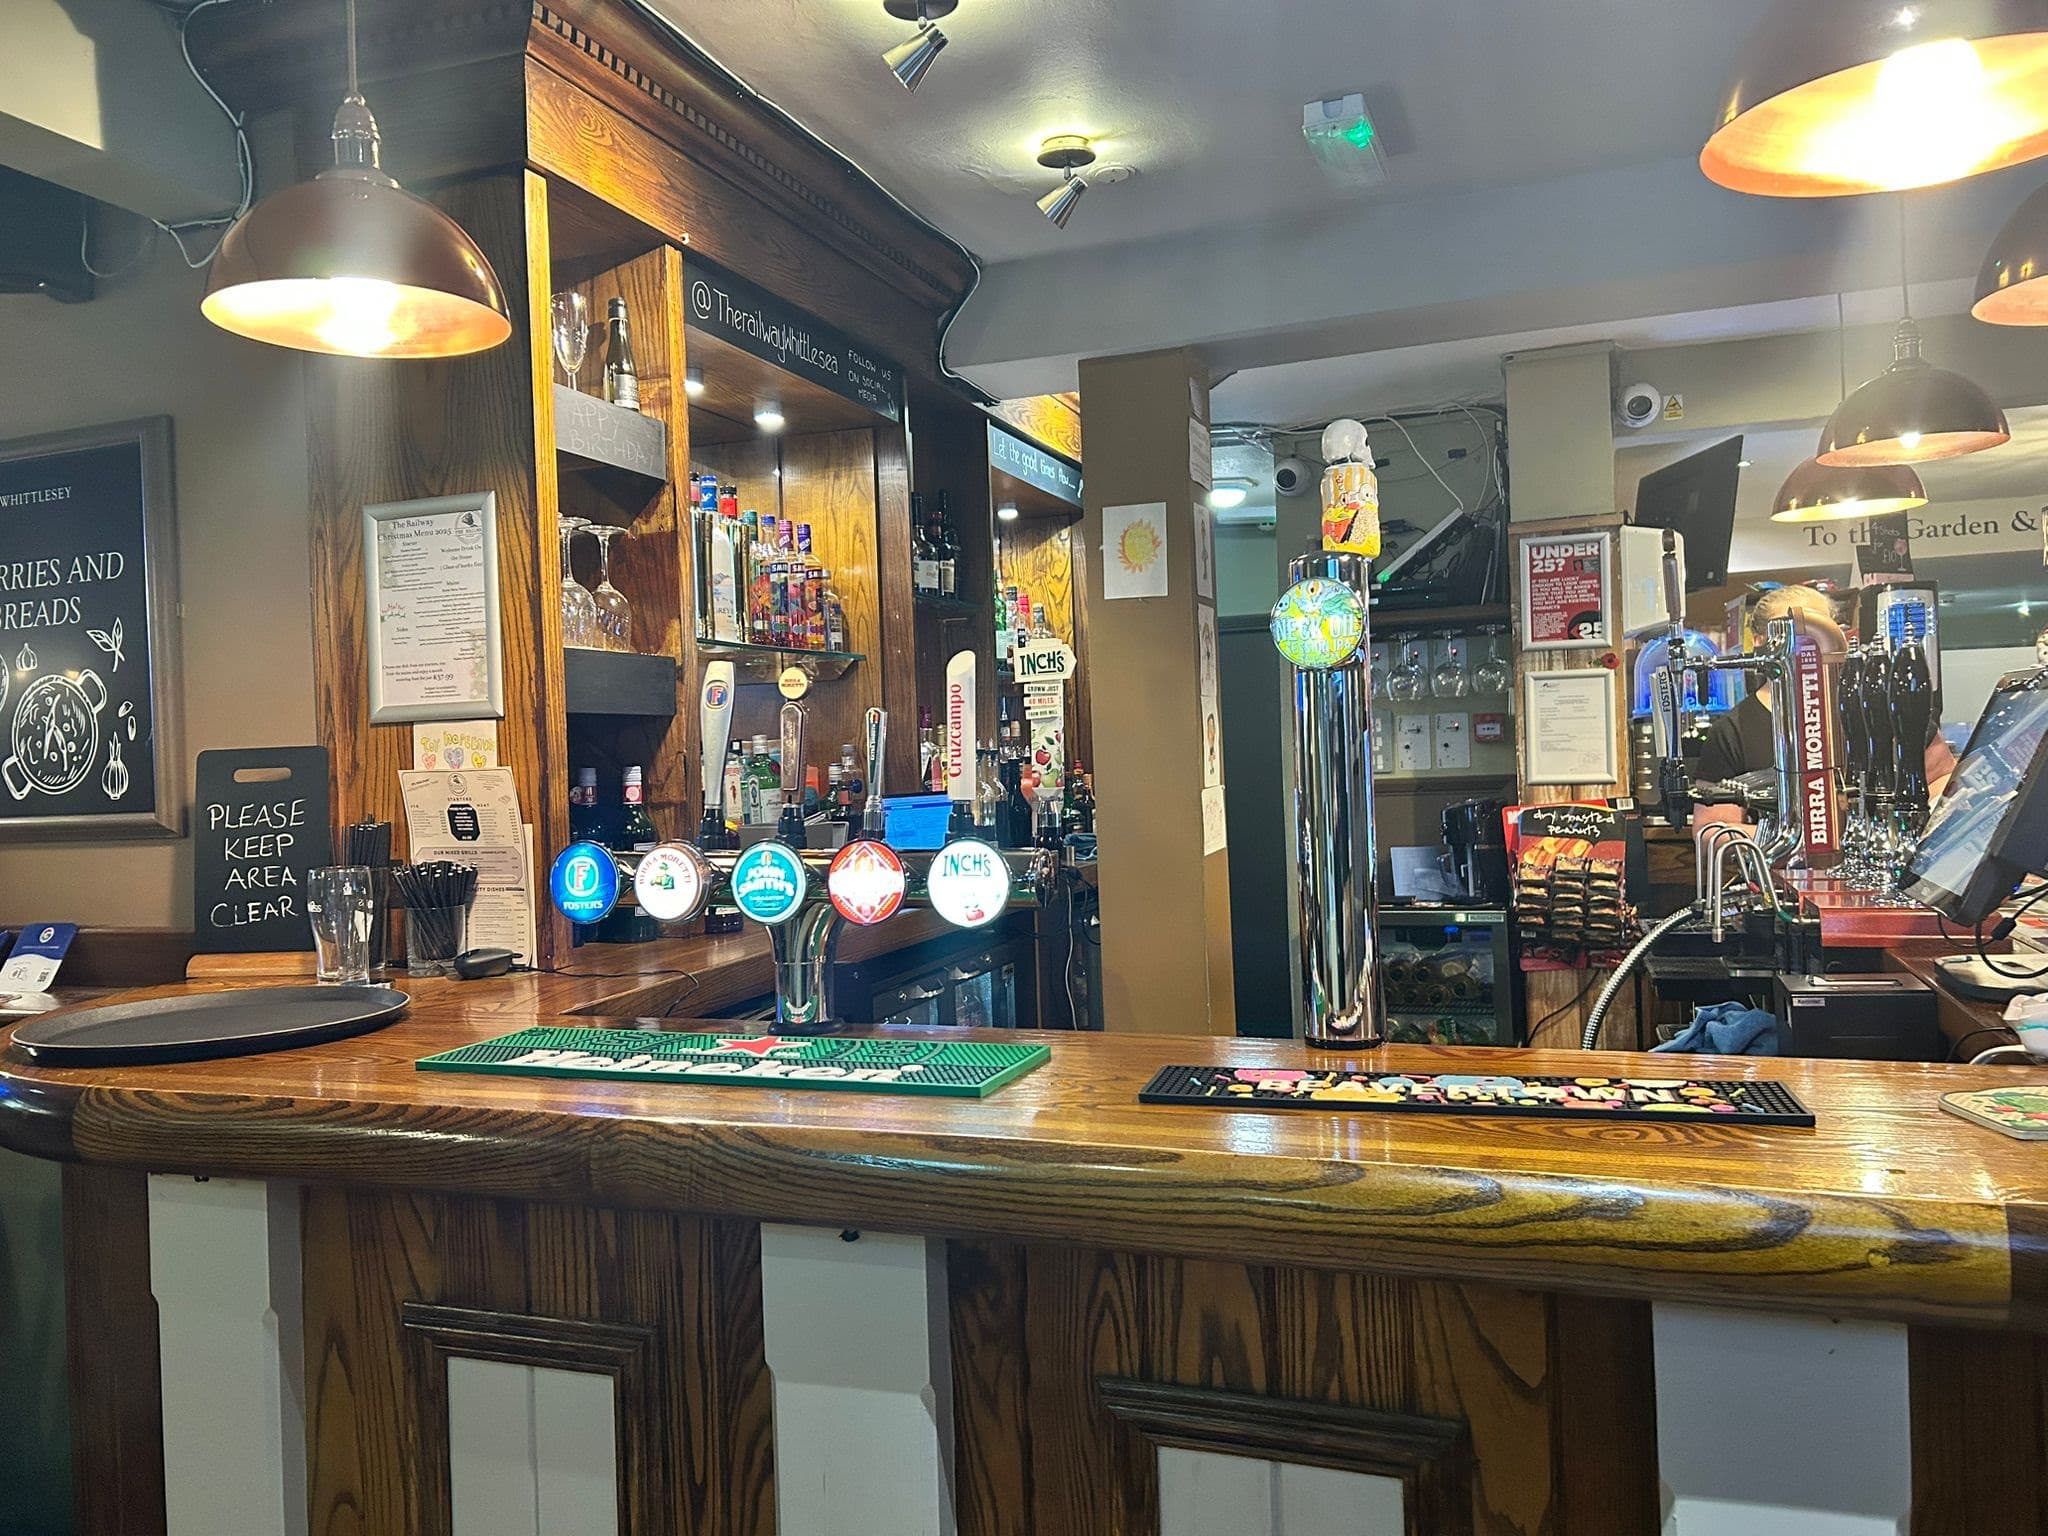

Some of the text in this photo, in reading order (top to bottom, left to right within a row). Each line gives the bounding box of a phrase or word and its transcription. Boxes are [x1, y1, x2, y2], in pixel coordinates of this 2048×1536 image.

[848, 349, 893, 381] FOLLOW US
[848, 370, 887, 394] ON SOCIAL
[857, 389, 878, 402] MEDIA
[993, 432, 1006, 460] Let
[1009, 442, 1020, 465] the
[1022, 452, 1038, 476] good
[1040, 458, 1056, 478] times
[0, 486, 72, 508] WHITTLESEY
[377, 531, 413, 542] Christmas
[413, 529, 434, 538] Menu
[434, 527, 452, 538] 2025
[393, 519, 434, 530] The Railway
[1803, 510, 2039, 547] To th Garden &
[1531, 542, 1600, 560] UNDER
[66, 551, 125, 585] AND
[1532, 558, 1566, 574] 25?
[0, 596, 82, 631] READS
[1037, 697, 1055, 705] MILES
[949, 683, 966, 778] Cruzcampo
[1801, 672, 1828, 845] BIRRA MORETTI
[206, 798, 308, 831] PLEASE
[1532, 808, 1556, 825] dry
[1560, 811, 1616, 825] roasted
[1547, 824, 1601, 838] peanuts
[224, 833, 295, 861] KEEP
[224, 865, 298, 891] AREA
[210, 895, 299, 928] CLEAR
[500, 1050, 904, 1082] Heineken
[1256, 1077, 1675, 1104] BEAVERTOWN
